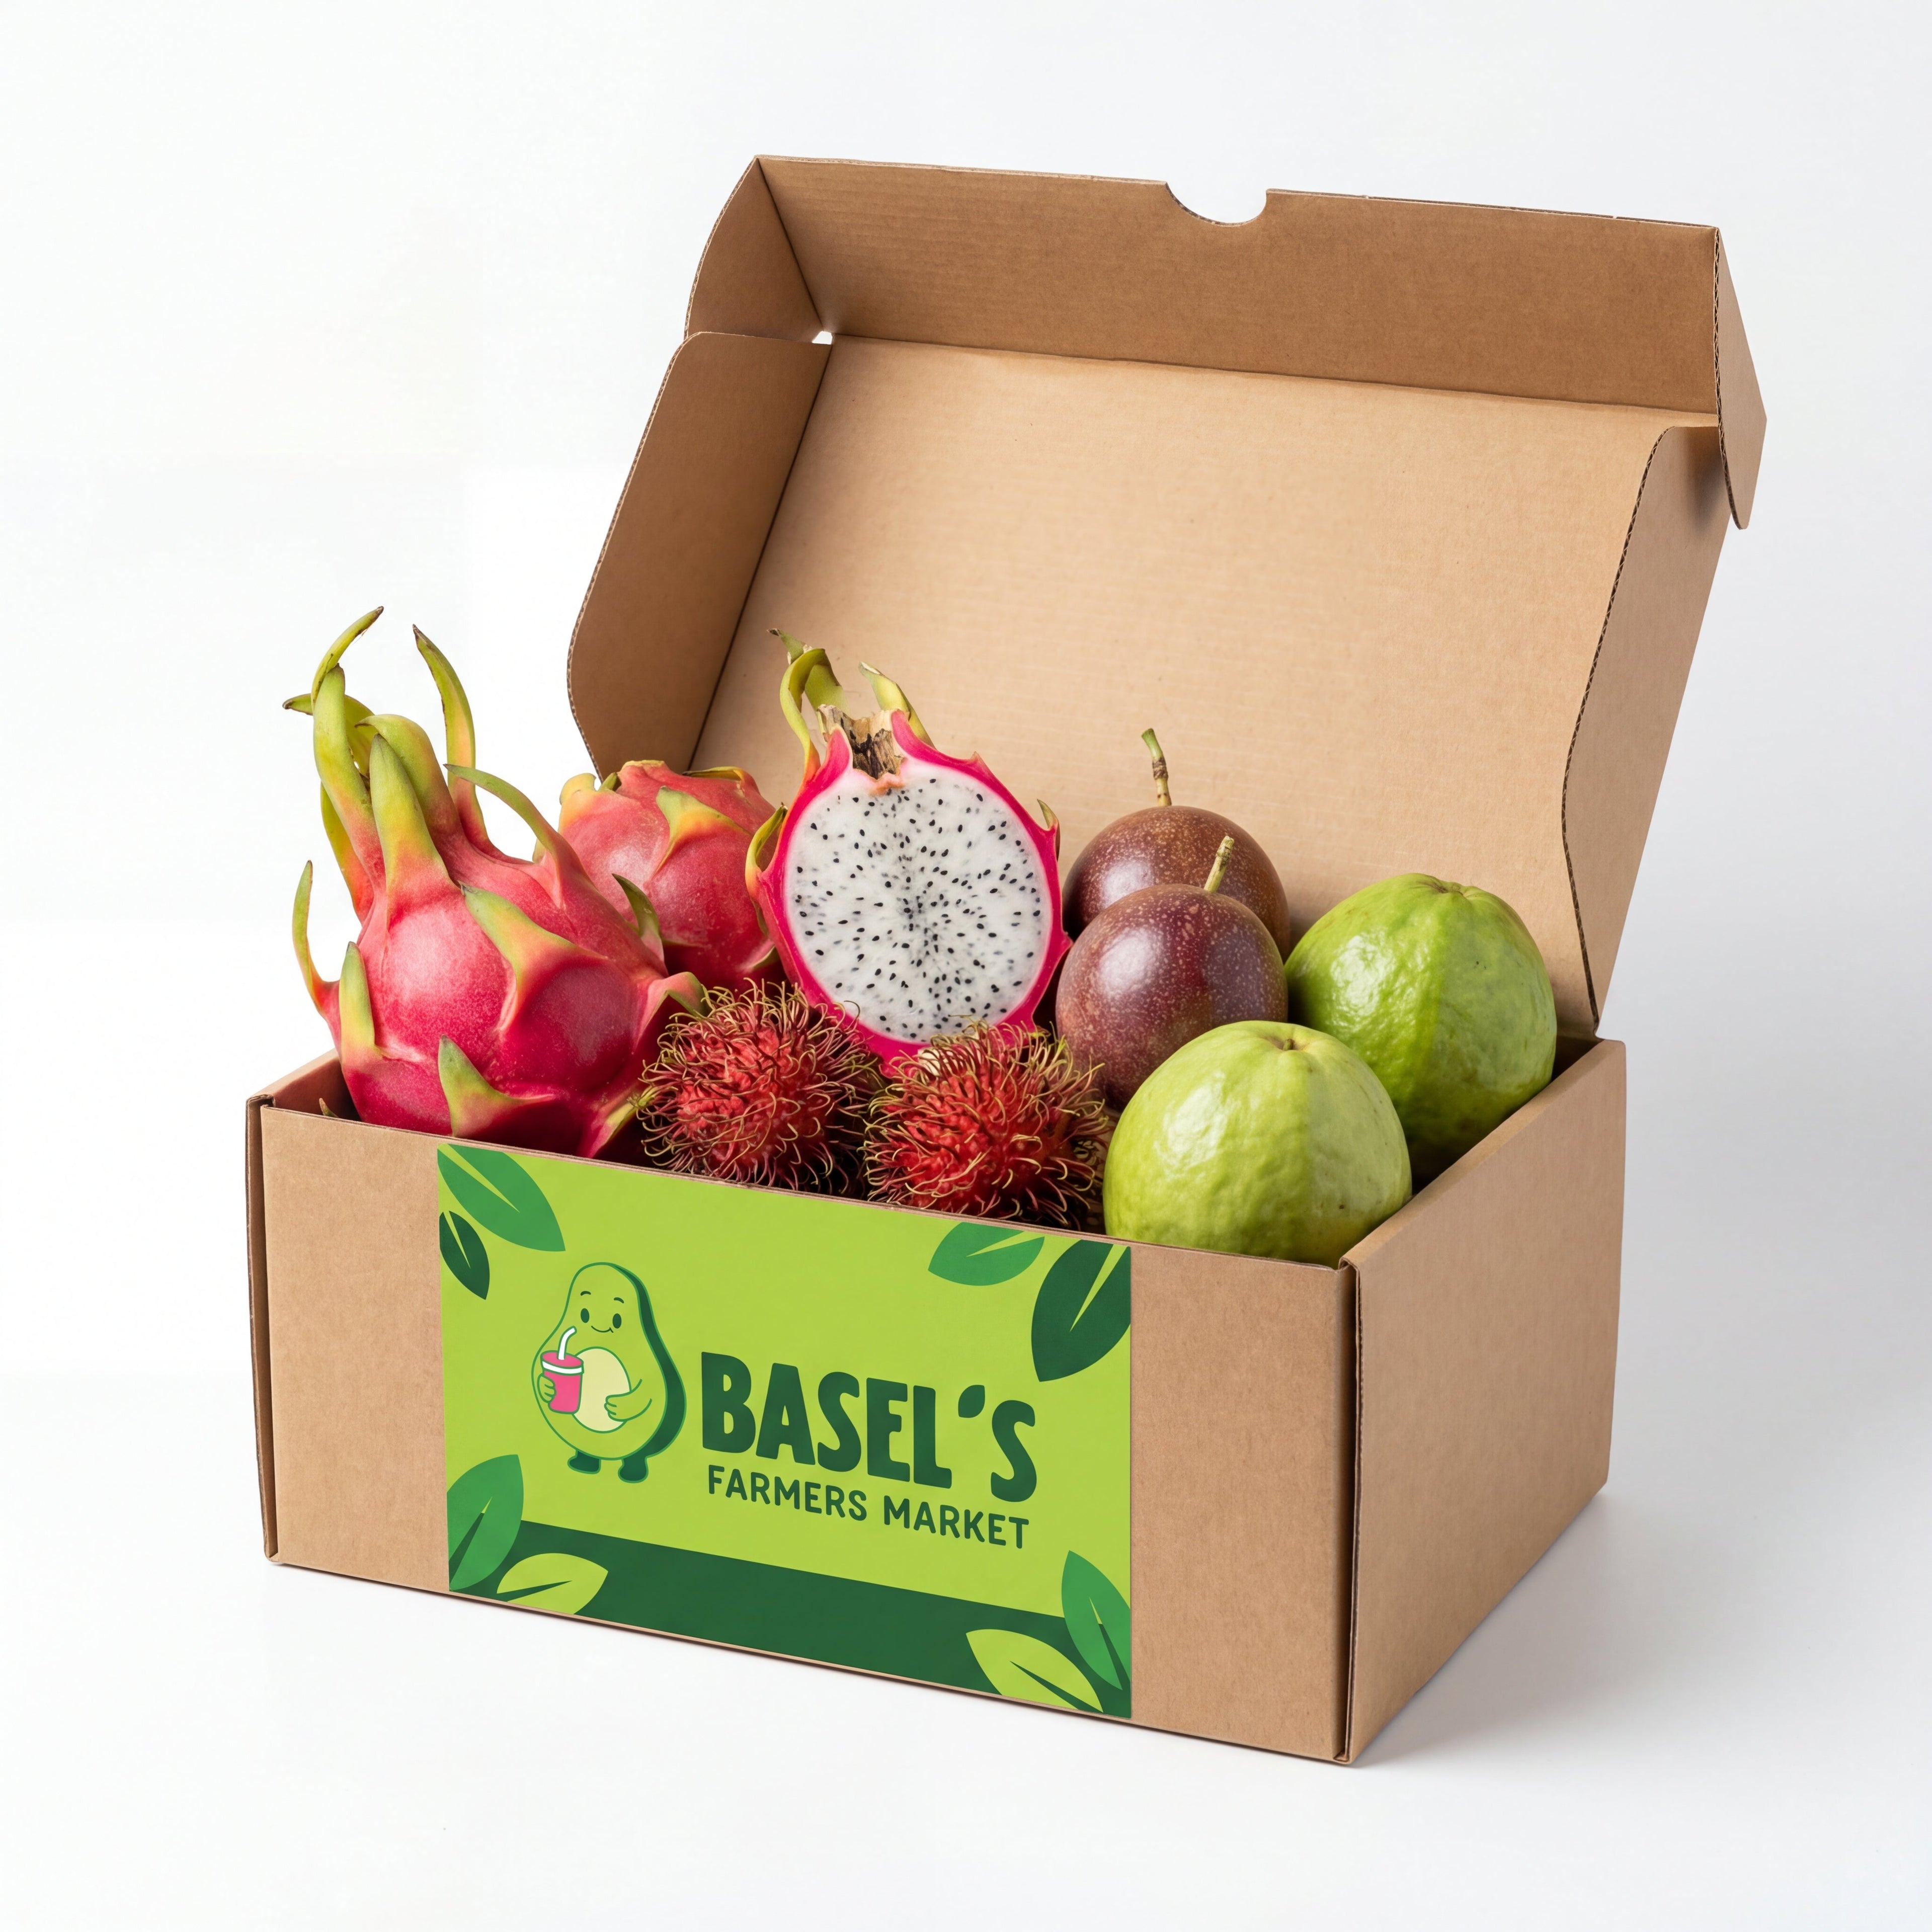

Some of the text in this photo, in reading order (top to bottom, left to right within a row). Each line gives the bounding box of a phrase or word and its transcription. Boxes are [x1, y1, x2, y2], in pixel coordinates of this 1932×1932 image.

[701, 1351, 1037, 1502] BASEL'S
[708, 1465, 1029, 1549] FARMERS MARKET
